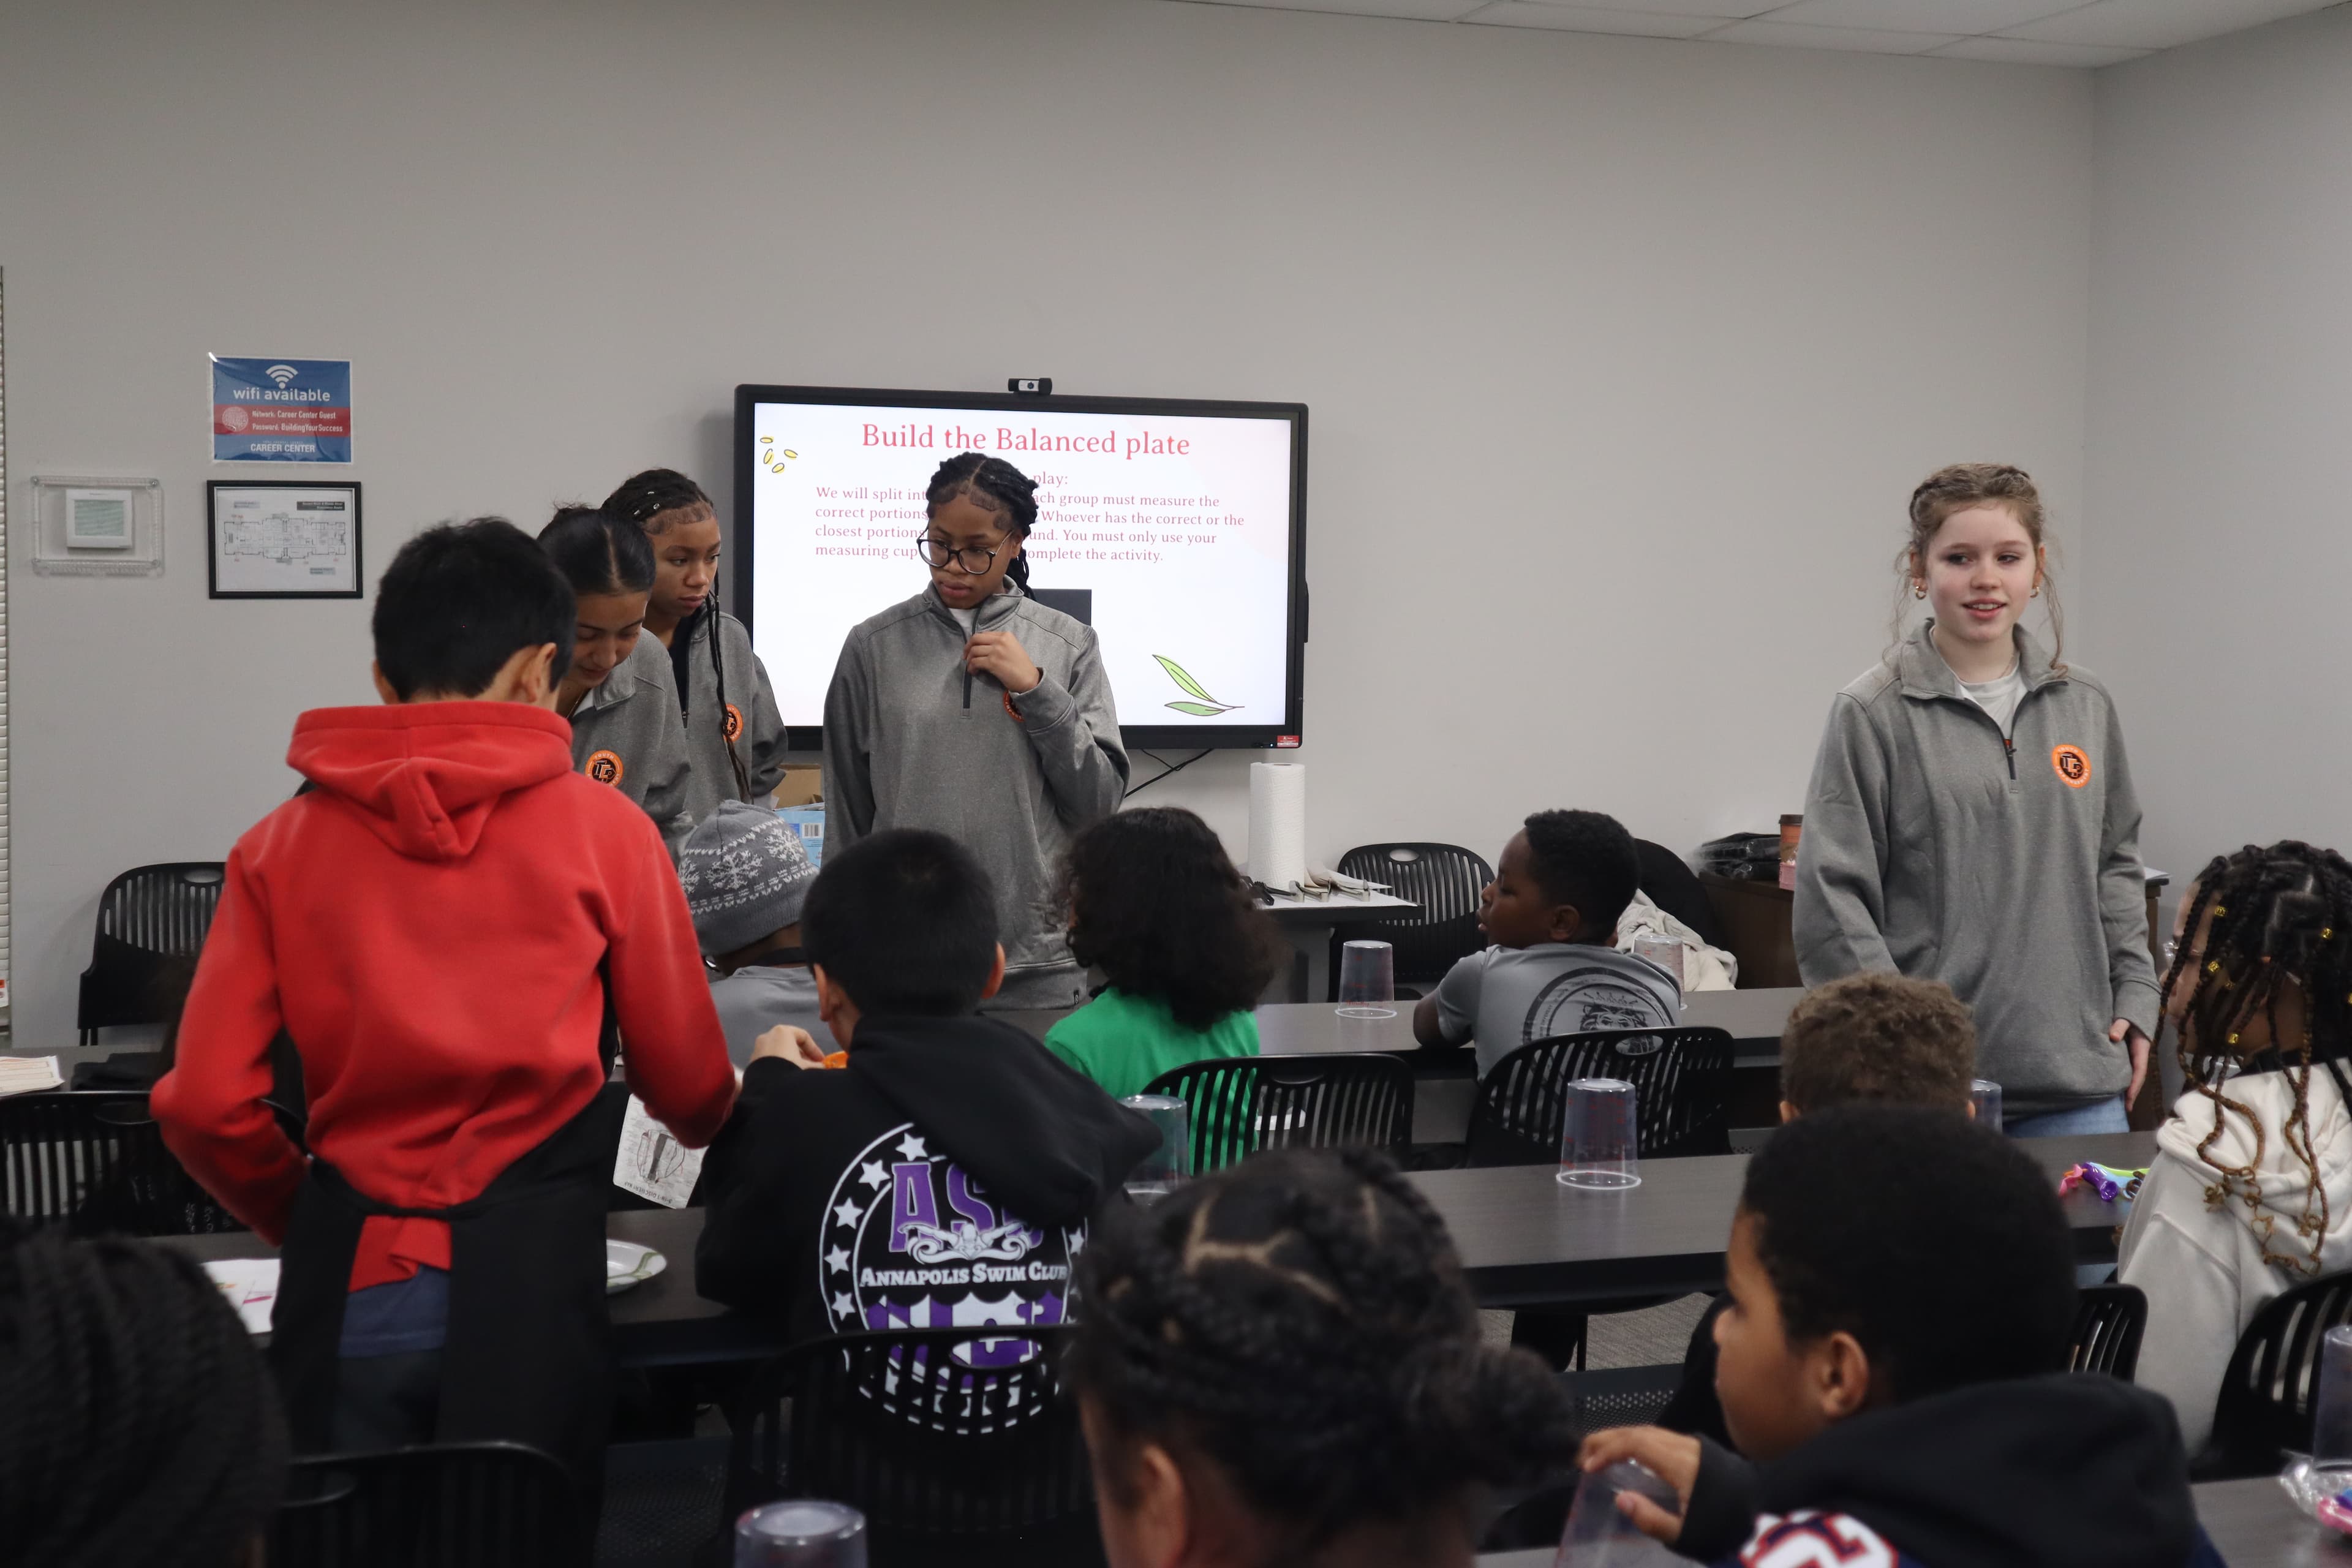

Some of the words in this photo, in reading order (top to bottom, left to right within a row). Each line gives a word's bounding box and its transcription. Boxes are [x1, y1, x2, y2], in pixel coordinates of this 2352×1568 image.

[233, 388, 260, 399] wifi
[264, 389, 331, 402] available
[319, 411, 336, 420] Guest
[251, 443, 282, 452] CAREER
[284, 444, 315, 453] CENTER
[862, 424, 933, 448] Build
[945, 426, 986, 450] the
[997, 428, 1116, 453] Balanced
[1126, 431, 1189, 460] plate
[816, 487, 837, 499] We
[843, 488, 867, 500] will
[873, 488, 902, 503] split
[1032, 492, 1055, 503] ach
[1060, 495, 1098, 507] group
[1103, 495, 1135, 505] must
[1140, 496, 1195, 507] measure
[1199, 496, 1219, 507] the
[815, 508, 864, 518] correct
[1041, 510, 1101, 523] Whoever
[1105, 511, 1127, 524] has
[1132, 513, 1152, 524] the
[1156, 514, 1201, 526] correct
[1206, 516, 1219, 526] or
[1224, 514, 1244, 526] the
[815, 525, 862, 537] closest
[1063, 529, 1087, 541] You
[1092, 532, 1124, 542] must
[1129, 531, 1157, 545] only
[1162, 533, 1183, 543] use
[1187, 535, 1216, 546] your
[815, 545, 889, 560] measuring
[1028, 548, 1082, 562] omplete
[1086, 549, 1106, 560] the
[1111, 549, 1164, 564] activity.
[889, 1162, 1043, 1253] AS
[859, 1267, 970, 1287] ANNAPOLIS
[972, 1263, 1027, 1285] SWIM
[1028, 1260, 1068, 1281] CLUB
